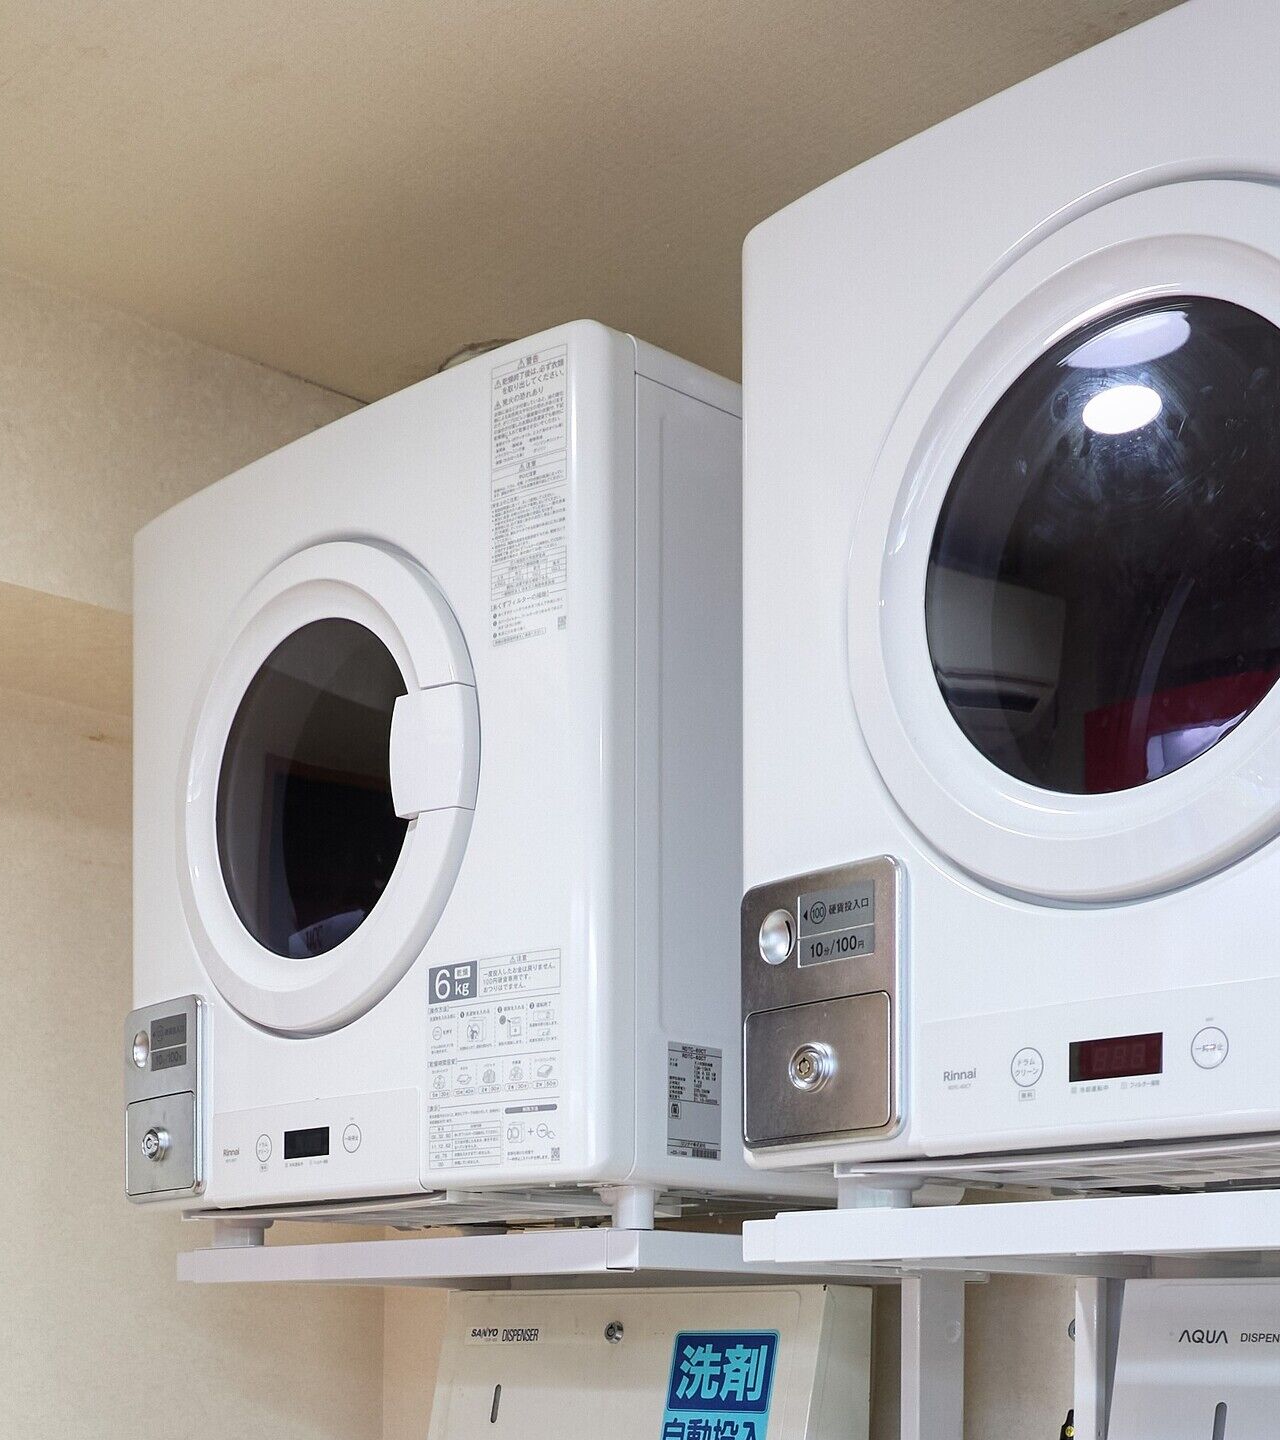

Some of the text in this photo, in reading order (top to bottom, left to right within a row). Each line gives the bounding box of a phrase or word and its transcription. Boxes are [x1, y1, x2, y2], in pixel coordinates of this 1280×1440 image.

[828, 897, 869, 915] 硬貨投入口
[943, 1067, 977, 1081] Rinnai
[471, 1328, 539, 1342] SANYO DISPENSER
[1178, 1329, 1229, 1344] AQUA
[676, 1344, 768, 1402] 洗剤
